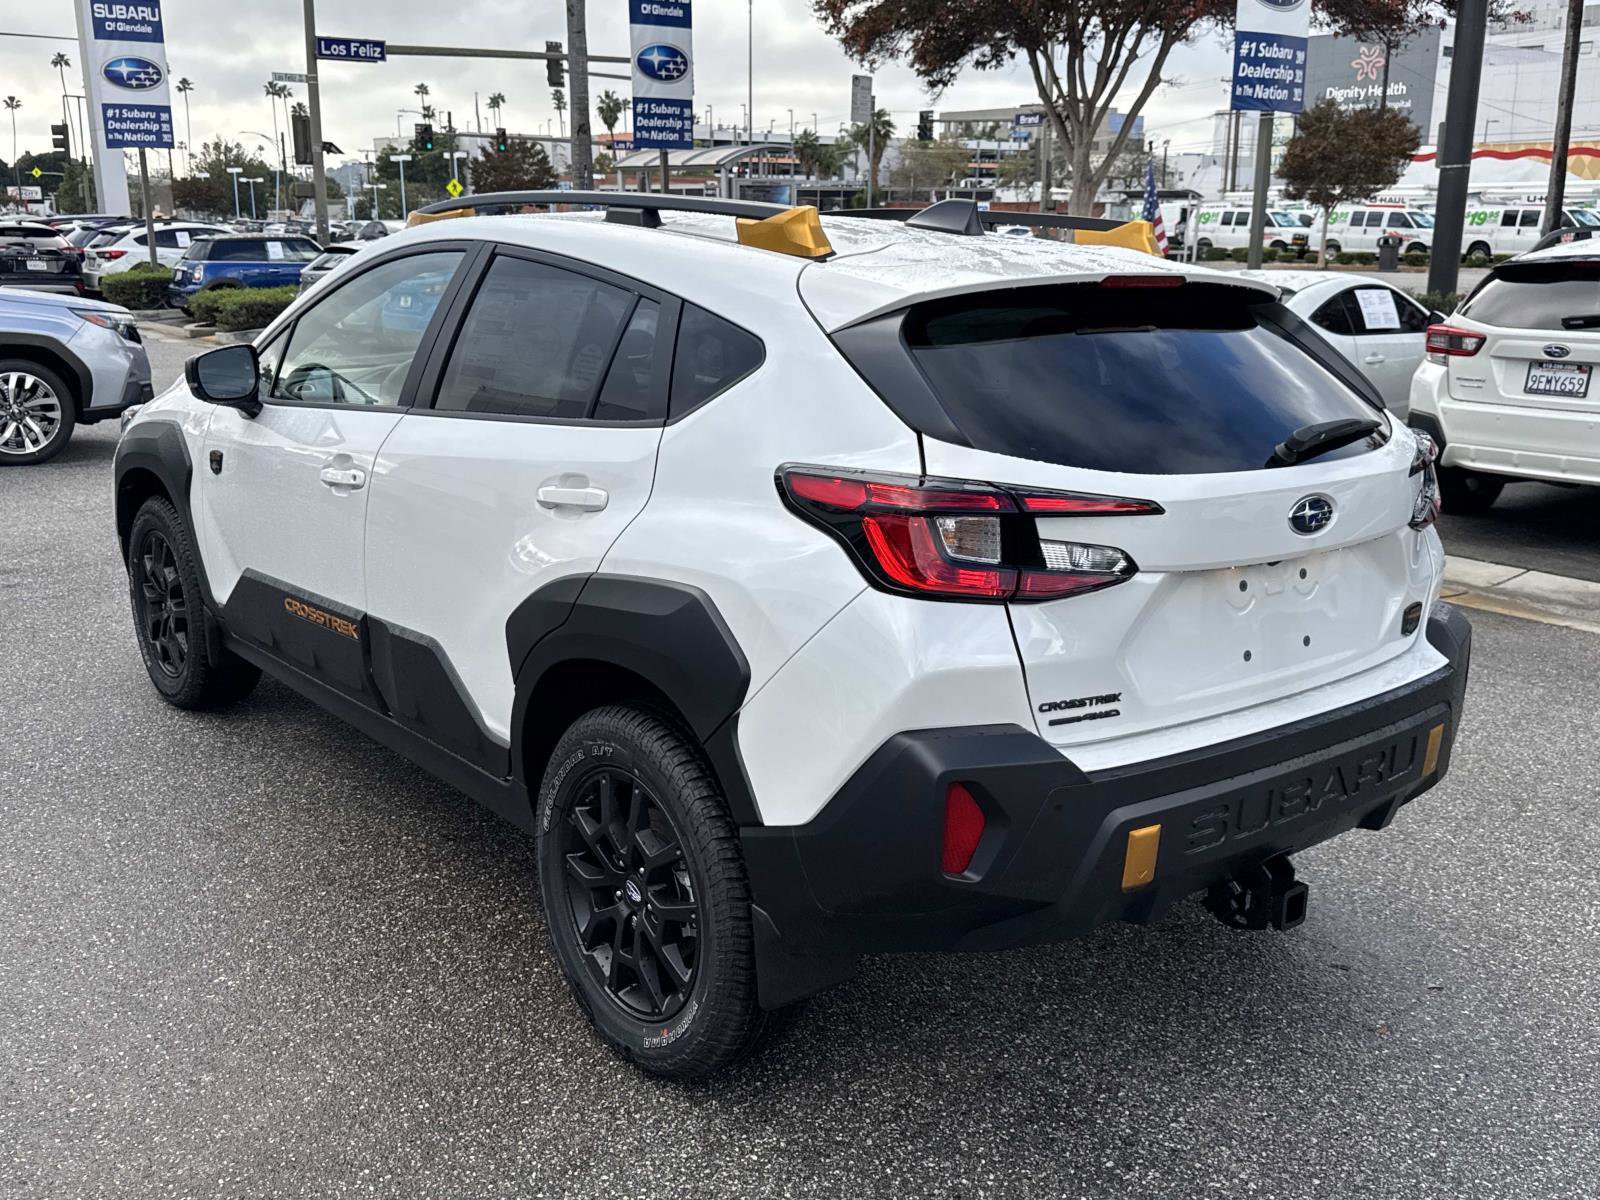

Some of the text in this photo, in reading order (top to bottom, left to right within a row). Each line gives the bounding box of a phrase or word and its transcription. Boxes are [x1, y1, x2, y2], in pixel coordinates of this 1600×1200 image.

[93, 3, 160, 22] SUBARU
[641, 4, 684, 17] Of Glendale
[105, 22, 153, 33] Of Glendale
[321, 40, 382, 58] Los Feliz
[1239, 41, 1256, 57] #1
[1257, 43, 1294, 59] Subaru
[1238, 62, 1294, 84] Dealership
[1254, 84, 1289, 101] Nation
[1326, 85, 1367, 102] Dignity
[106, 109, 120, 118] #1
[122, 109, 156, 120] Subaru
[636, 104, 649, 114] #1
[650, 104, 681, 115] Subaru
[108, 121, 159, 132] Dealership
[636, 117, 683, 130] Dealership
[1019, 115, 1039, 124] Brand
[124, 133, 156, 142] Nation
[650, 130, 679, 141] Nation
[1528, 374, 1585, 393] 9EMY659
[284, 597, 359, 640] CROSSTREK
[1038, 692, 1123, 713] CROSSTREK
[1185, 737, 1417, 856] SUBARU
